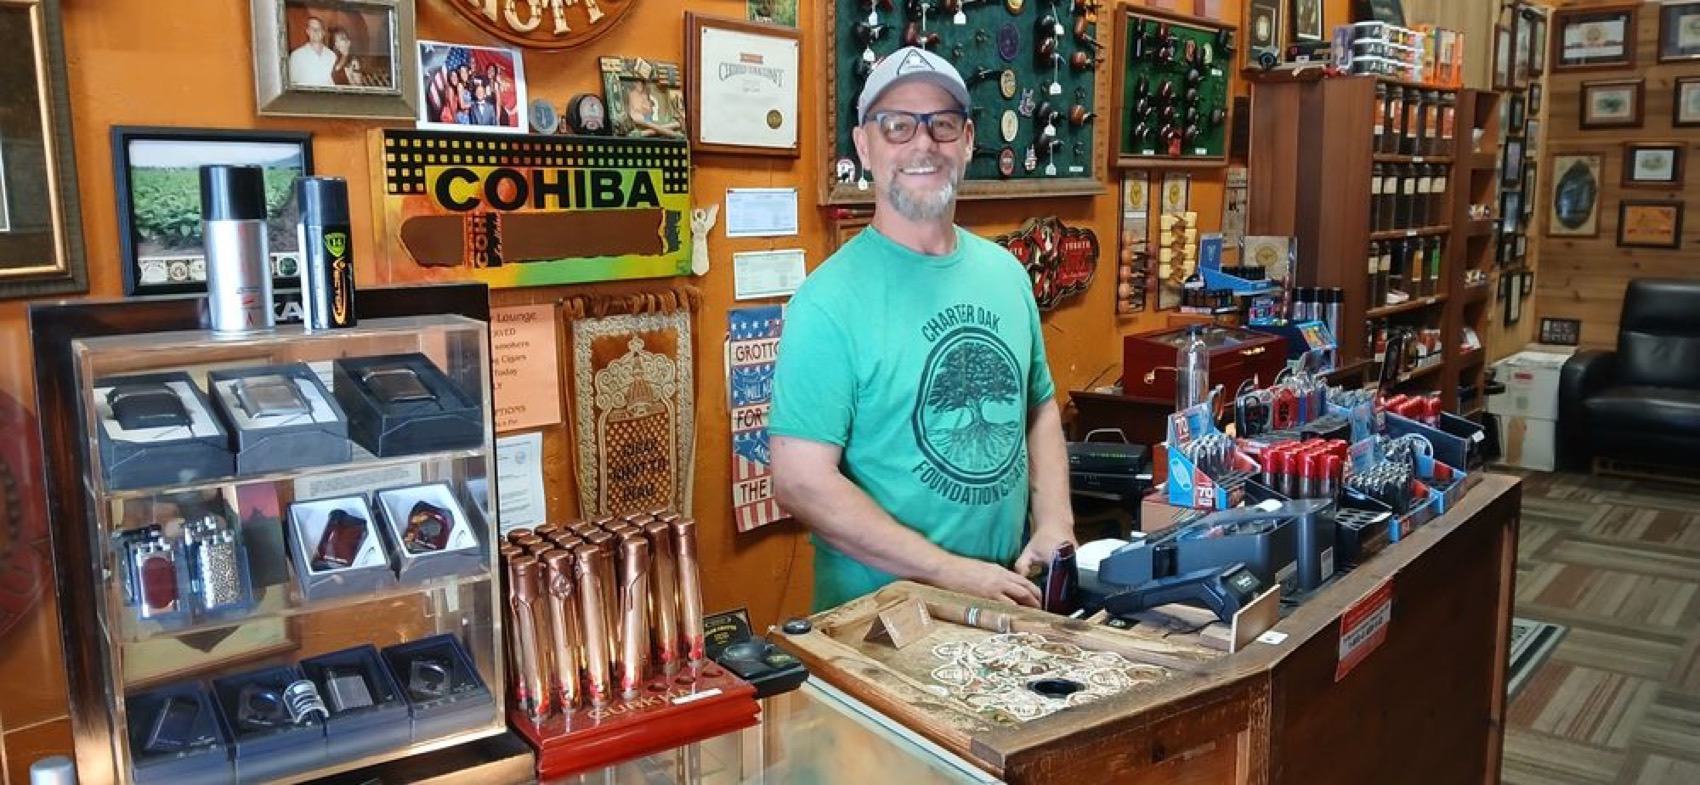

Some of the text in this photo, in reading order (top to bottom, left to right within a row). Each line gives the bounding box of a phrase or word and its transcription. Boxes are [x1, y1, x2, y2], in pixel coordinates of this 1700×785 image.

[435, 168, 660, 211] COHIBA
[497, 312, 537, 323] Lounge
[921, 304, 1001, 343] CHARTER OAK
[736, 408, 762, 427] FOR
[740, 479, 767, 503] THE
[912, 460, 1000, 506] FOUNDATION
[1199, 488, 1213, 498] 70
